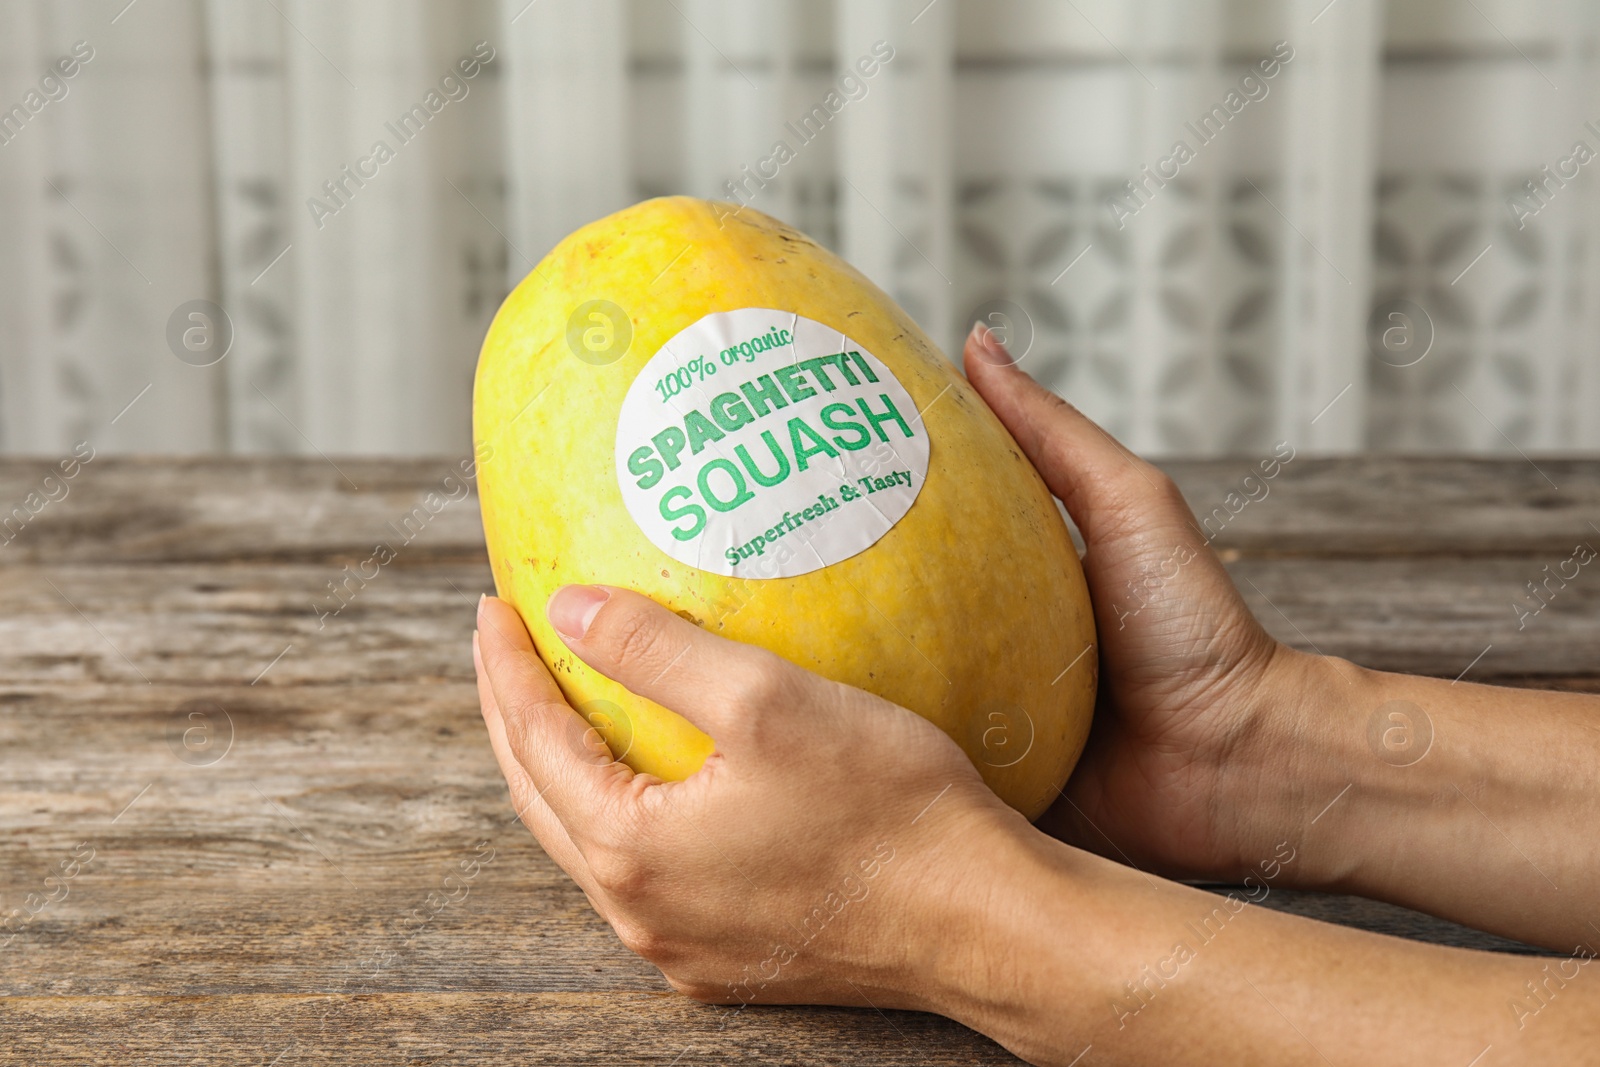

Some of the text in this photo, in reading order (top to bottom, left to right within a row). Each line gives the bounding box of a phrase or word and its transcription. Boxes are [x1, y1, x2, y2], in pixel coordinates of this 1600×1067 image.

[627, 351, 880, 490] SPAGHETTI
[655, 326, 793, 404] 100% organic
[658, 393, 915, 542] SQUASH
[724, 469, 912, 567] Superfresh & Tasty
